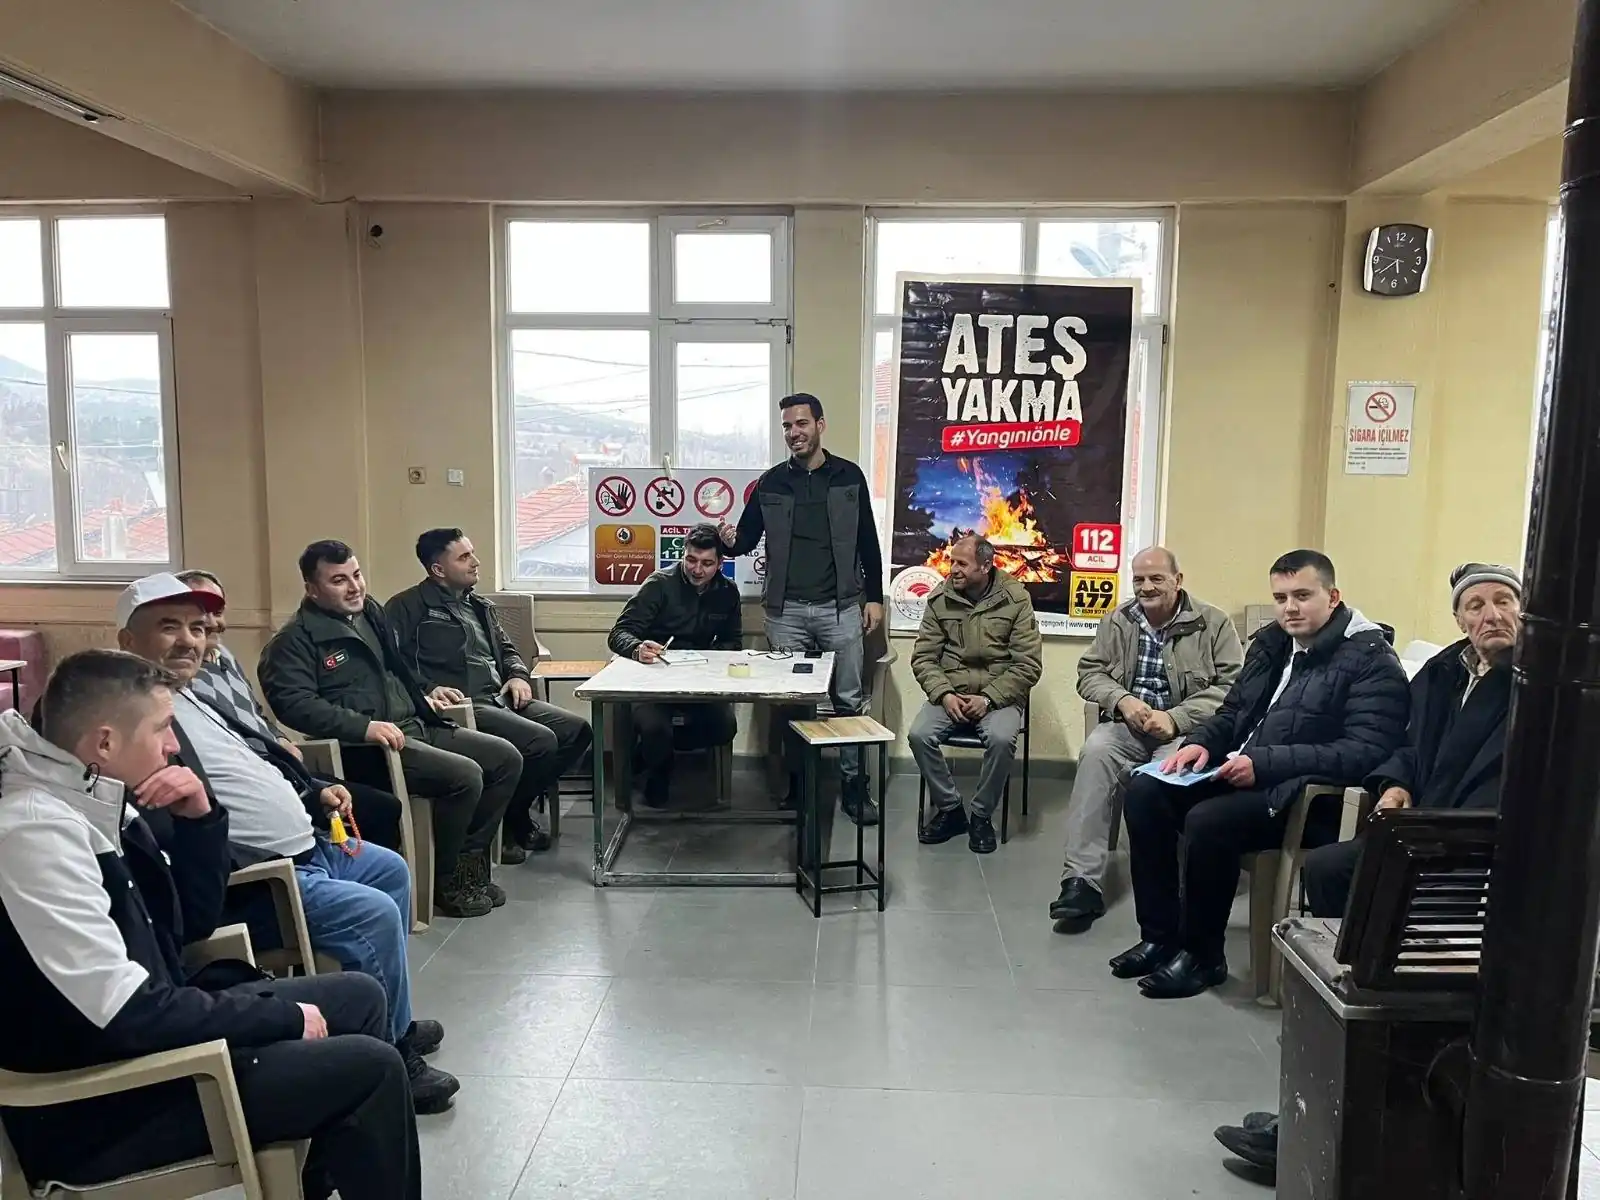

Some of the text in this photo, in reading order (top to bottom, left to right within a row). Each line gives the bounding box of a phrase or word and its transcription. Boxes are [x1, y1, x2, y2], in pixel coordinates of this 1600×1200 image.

[1396, 232, 1407, 241] 12
[1373, 255, 1380, 264] 9
[1415, 256, 1422, 266] 3
[1391, 278, 1398, 288] 6
[942, 313, 1088, 380] ATEŞ
[941, 377, 1083, 424] YAKMA
[1080, 528, 1114, 551] 112
[606, 563, 644, 582] 177
[1076, 580, 1114, 593] ALO
[1074, 593, 1113, 608] 177
